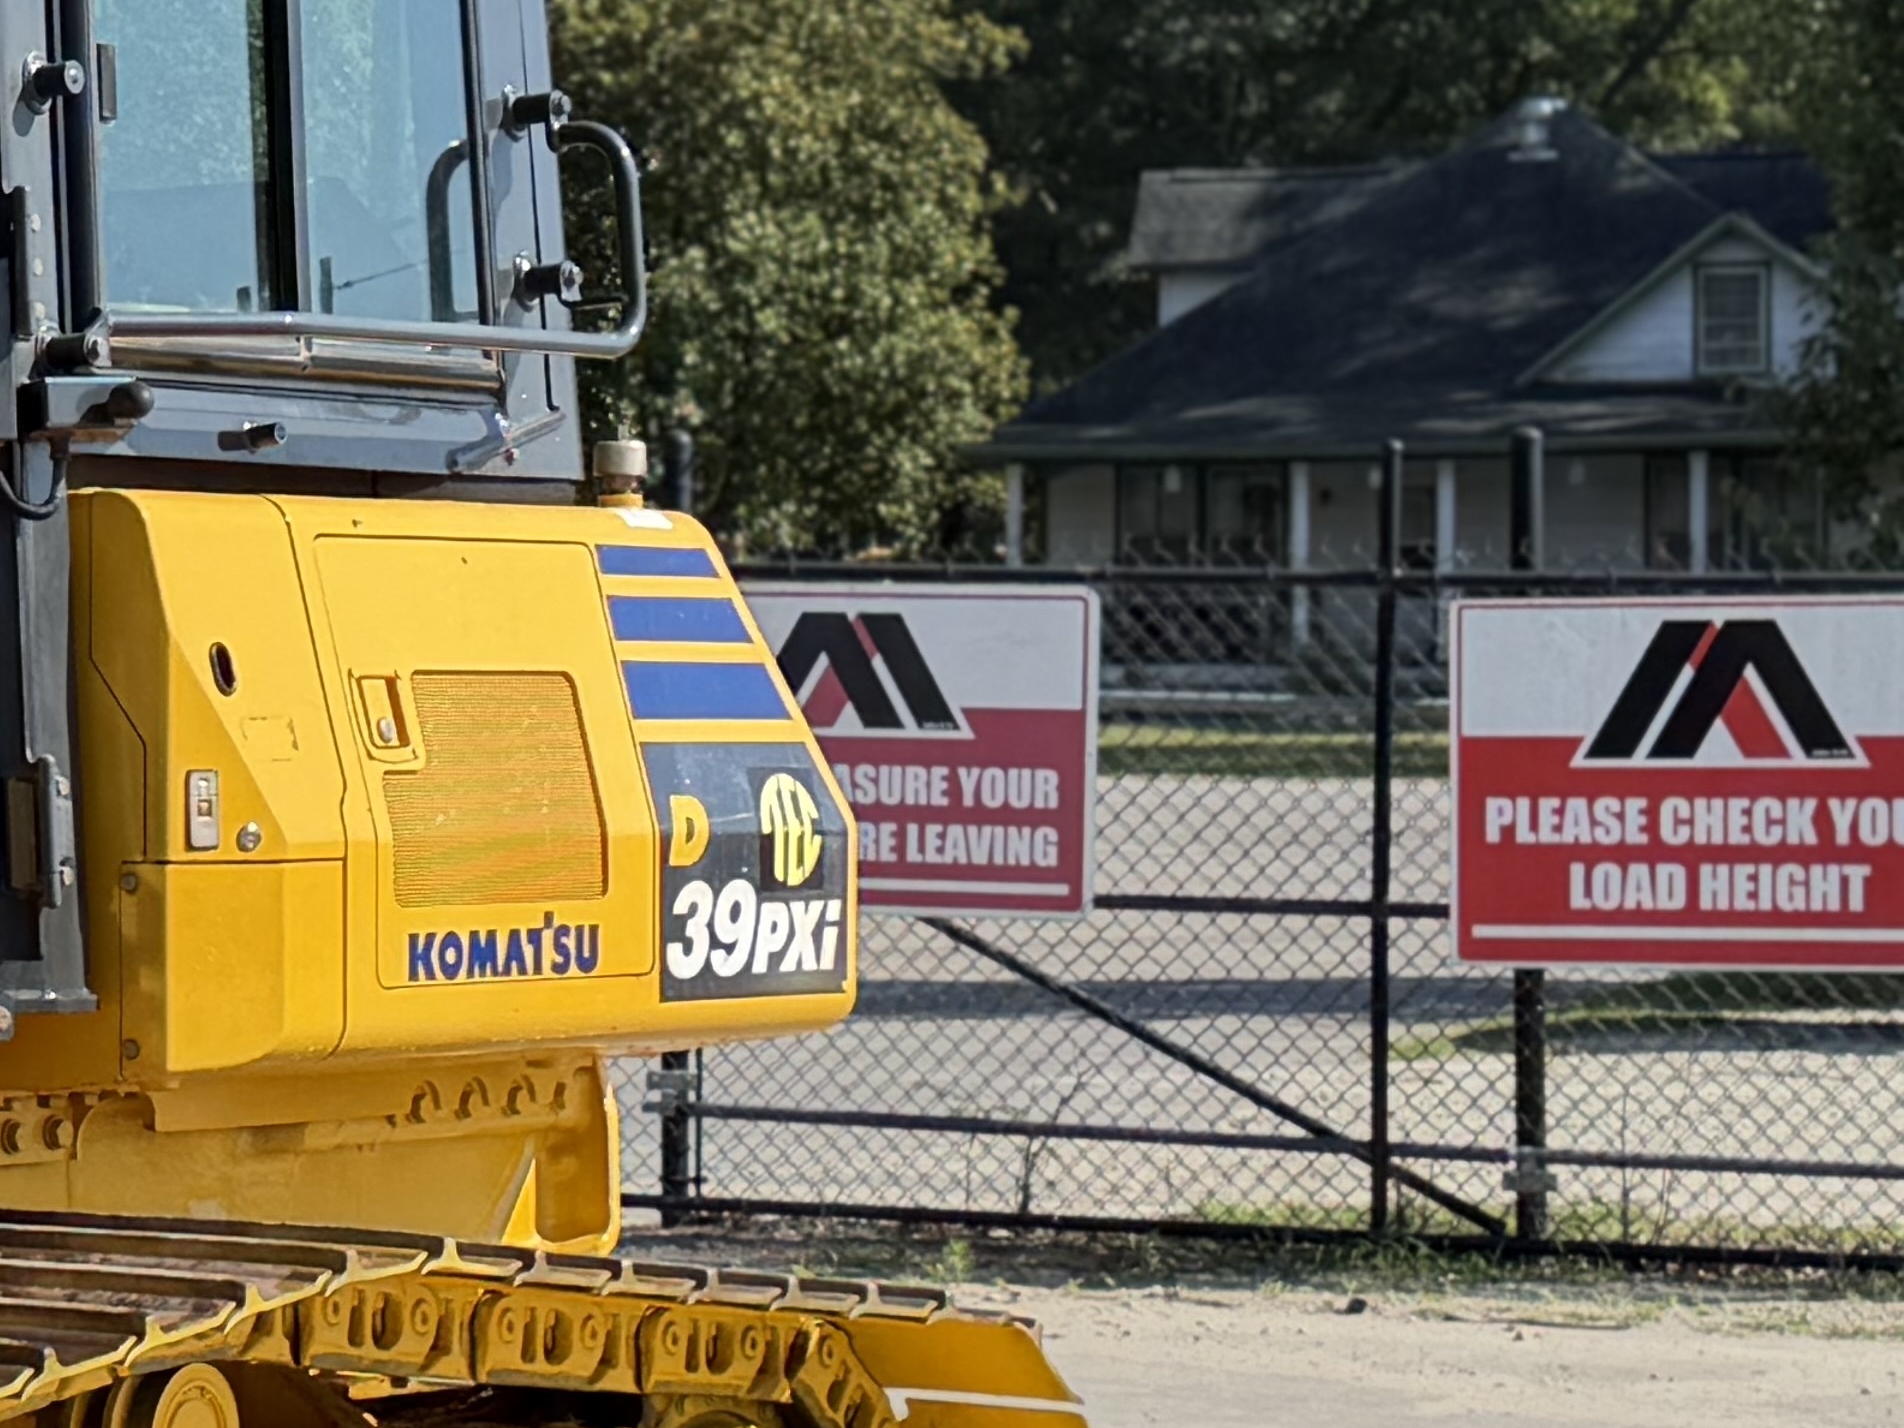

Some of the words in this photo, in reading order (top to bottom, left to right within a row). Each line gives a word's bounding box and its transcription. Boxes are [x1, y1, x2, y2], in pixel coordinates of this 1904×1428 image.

[958, 767, 1059, 809] YOUR
[669, 795, 710, 867] D
[906, 824, 1059, 867] LEAVING
[1485, 796, 1650, 846] PLEASE
[1659, 796, 1819, 847] CHECK
[1570, 862, 1687, 911] LOAD
[1699, 863, 1873, 913] HEIGHT
[407, 912, 599, 982] KOMATSU
[666, 879, 842, 980] 39PXi
